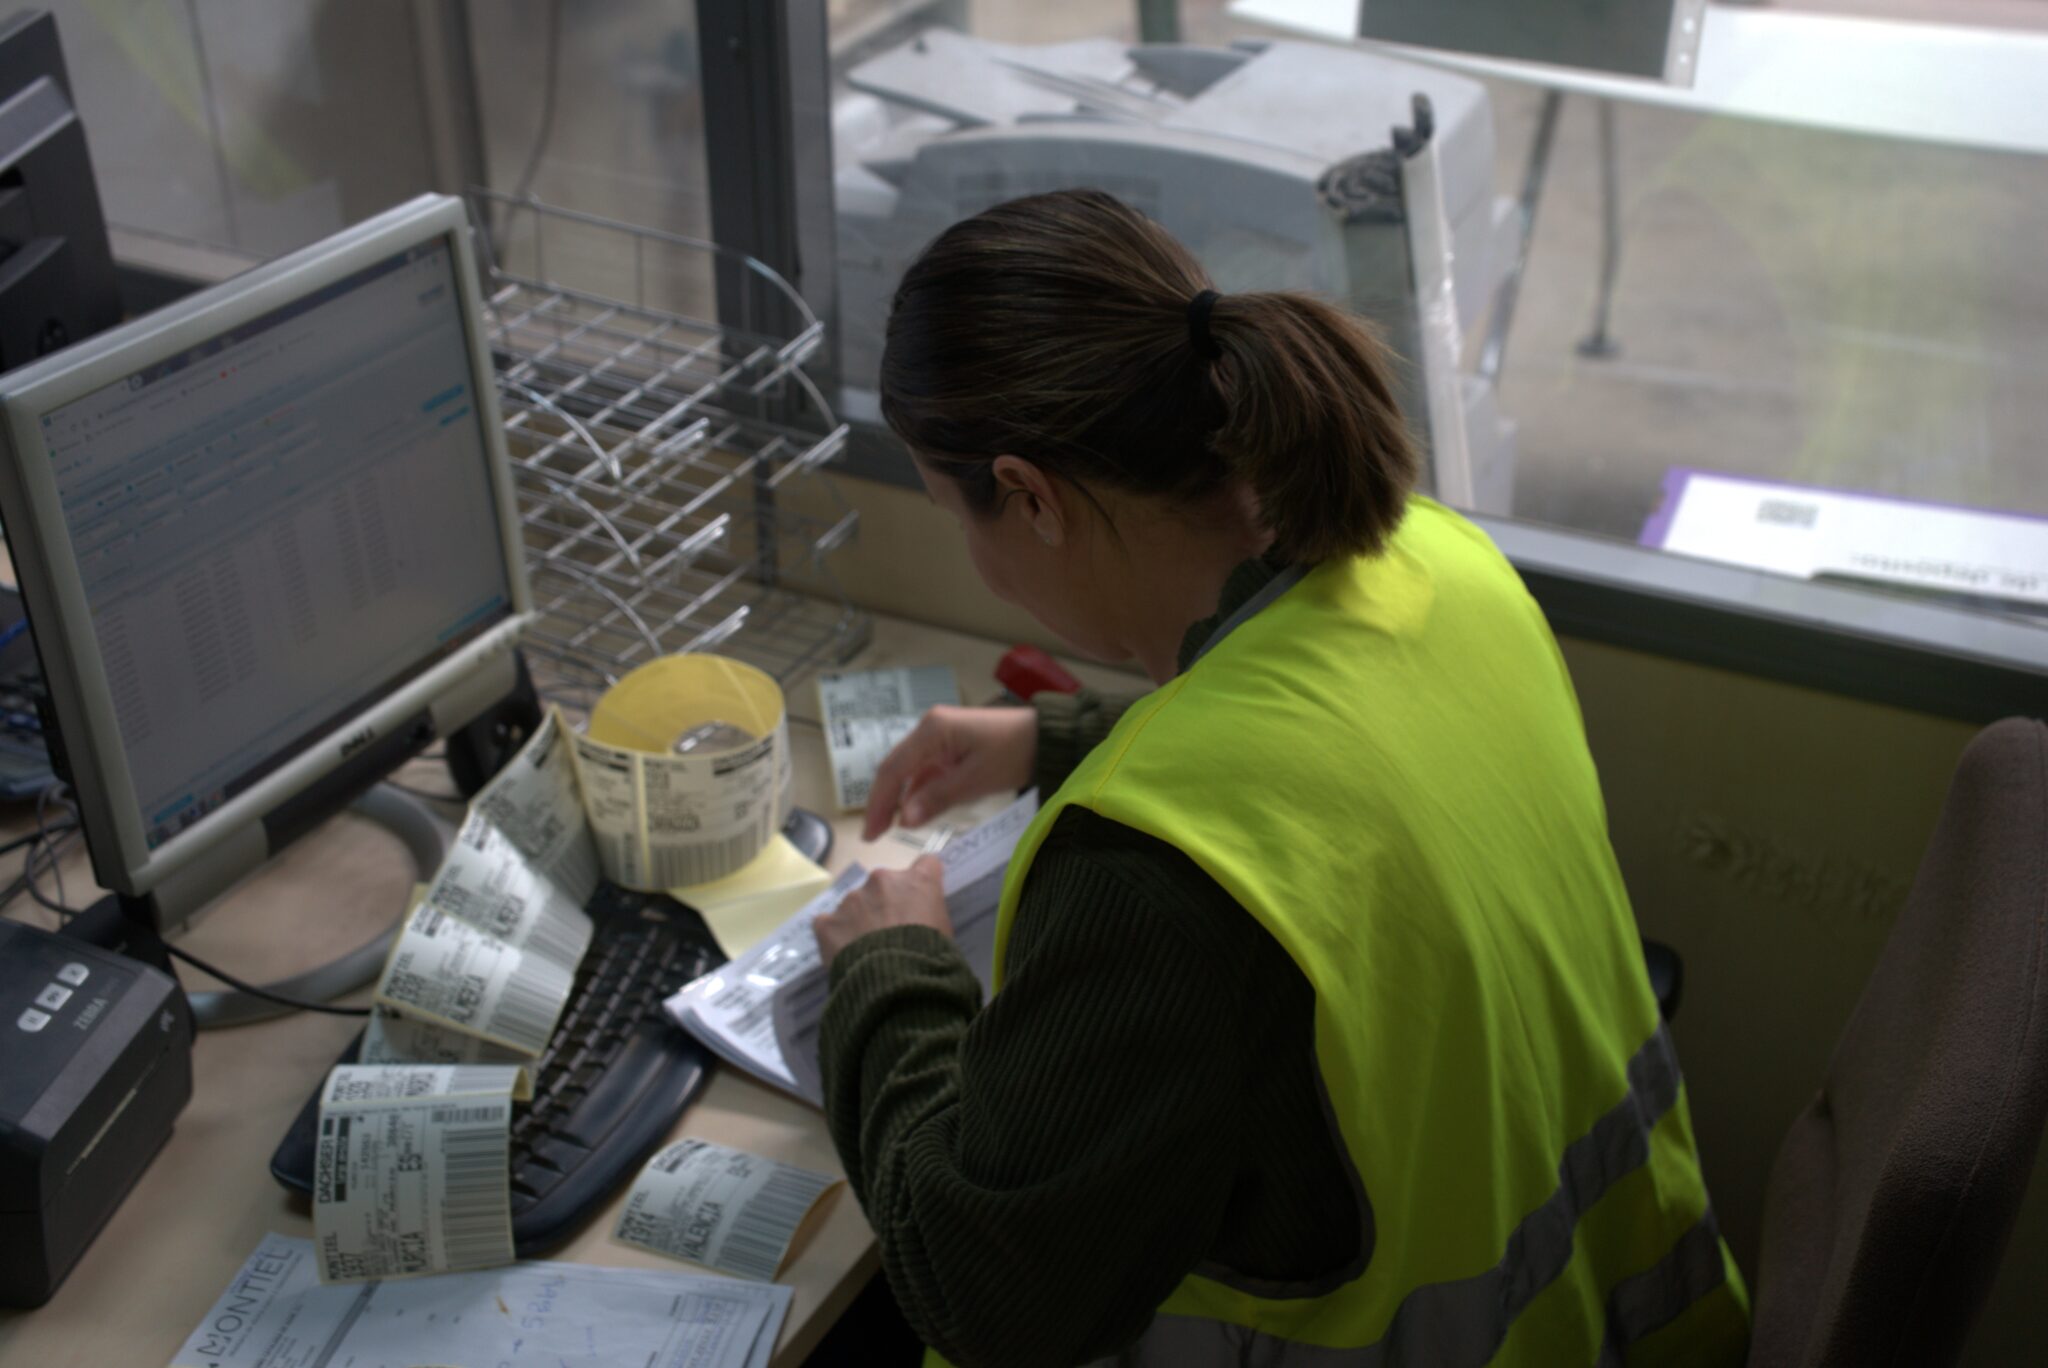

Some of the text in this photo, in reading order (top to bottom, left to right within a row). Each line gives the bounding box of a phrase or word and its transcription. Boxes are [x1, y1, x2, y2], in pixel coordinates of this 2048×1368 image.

[318, 1138, 334, 1204] DACHSER
[679, 1200, 724, 1260] VALENCIA
[196, 1249, 294, 1357] MONTIEL
